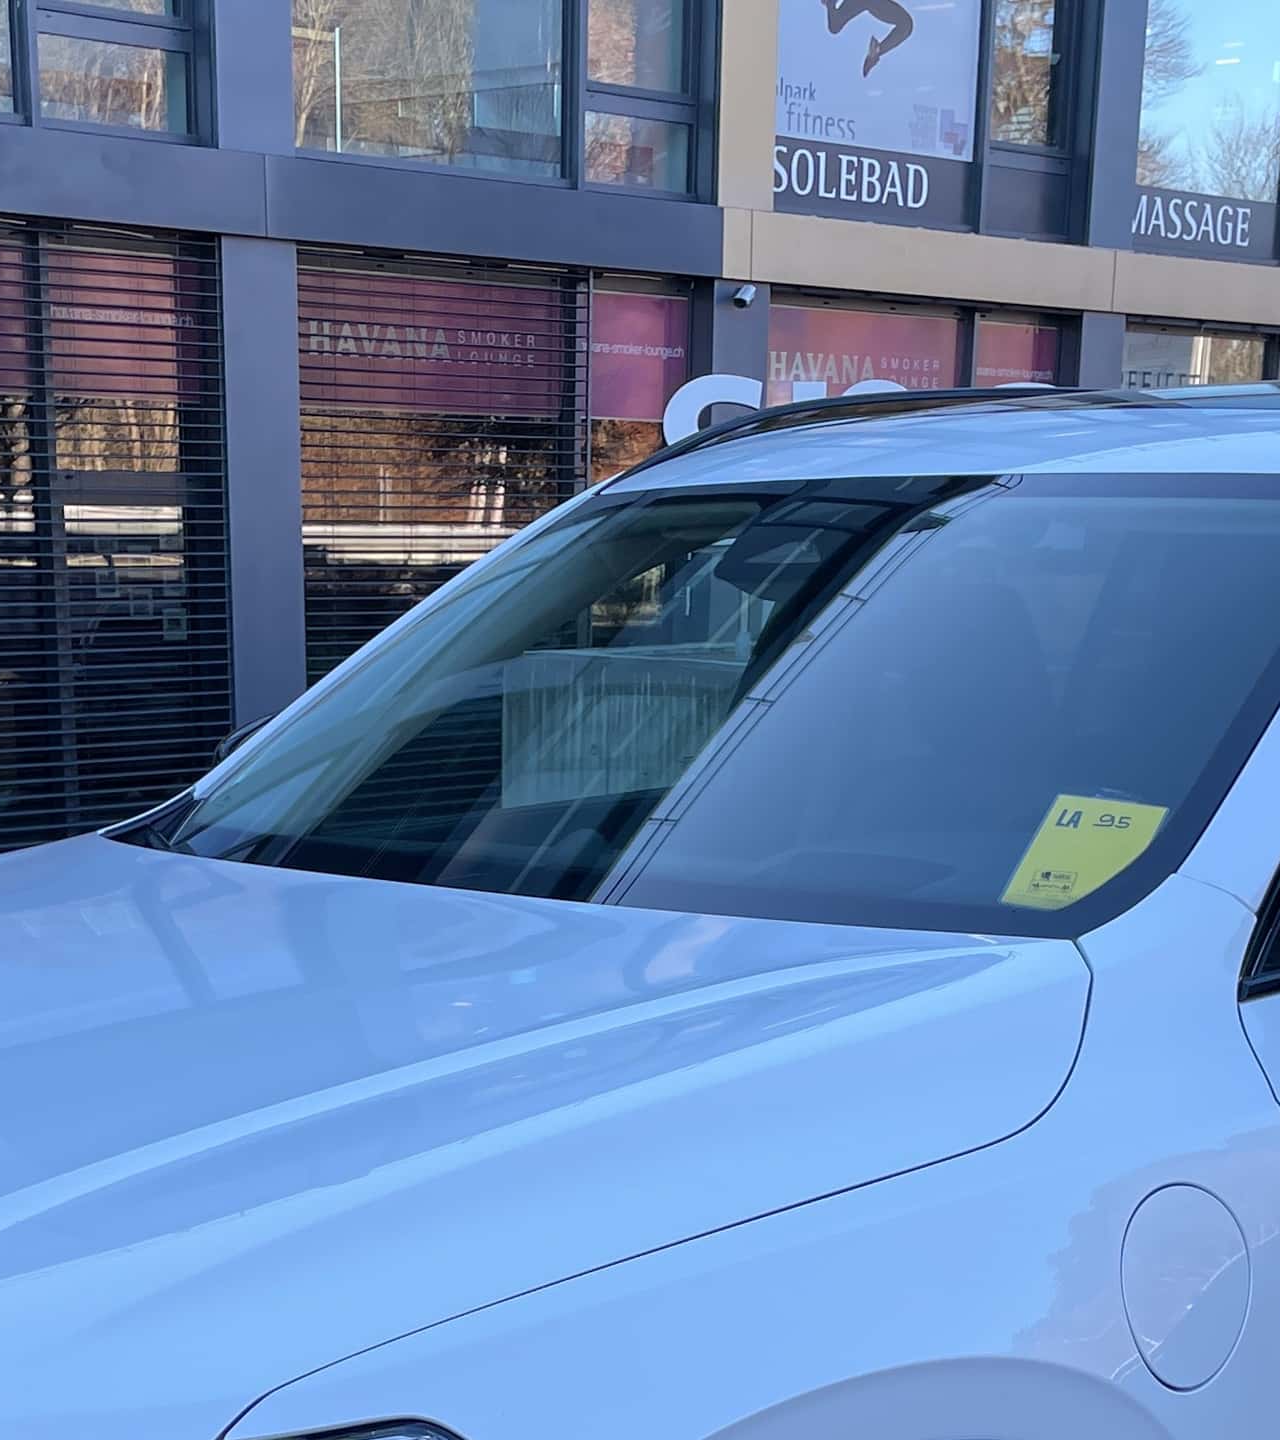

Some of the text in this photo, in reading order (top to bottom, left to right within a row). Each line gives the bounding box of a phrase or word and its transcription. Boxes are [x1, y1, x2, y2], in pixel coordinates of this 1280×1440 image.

[776, 76, 817, 104] lpark
[785, 101, 856, 141] fitness
[773, 145, 929, 208] SOLEBAD
[1131, 194, 1251, 247] MASSAGE
[308, 320, 536, 363] HAVANA SMOKER
[768, 351, 940, 384] HAVANA SMOKER
[1055, 808, 1083, 829] LA
